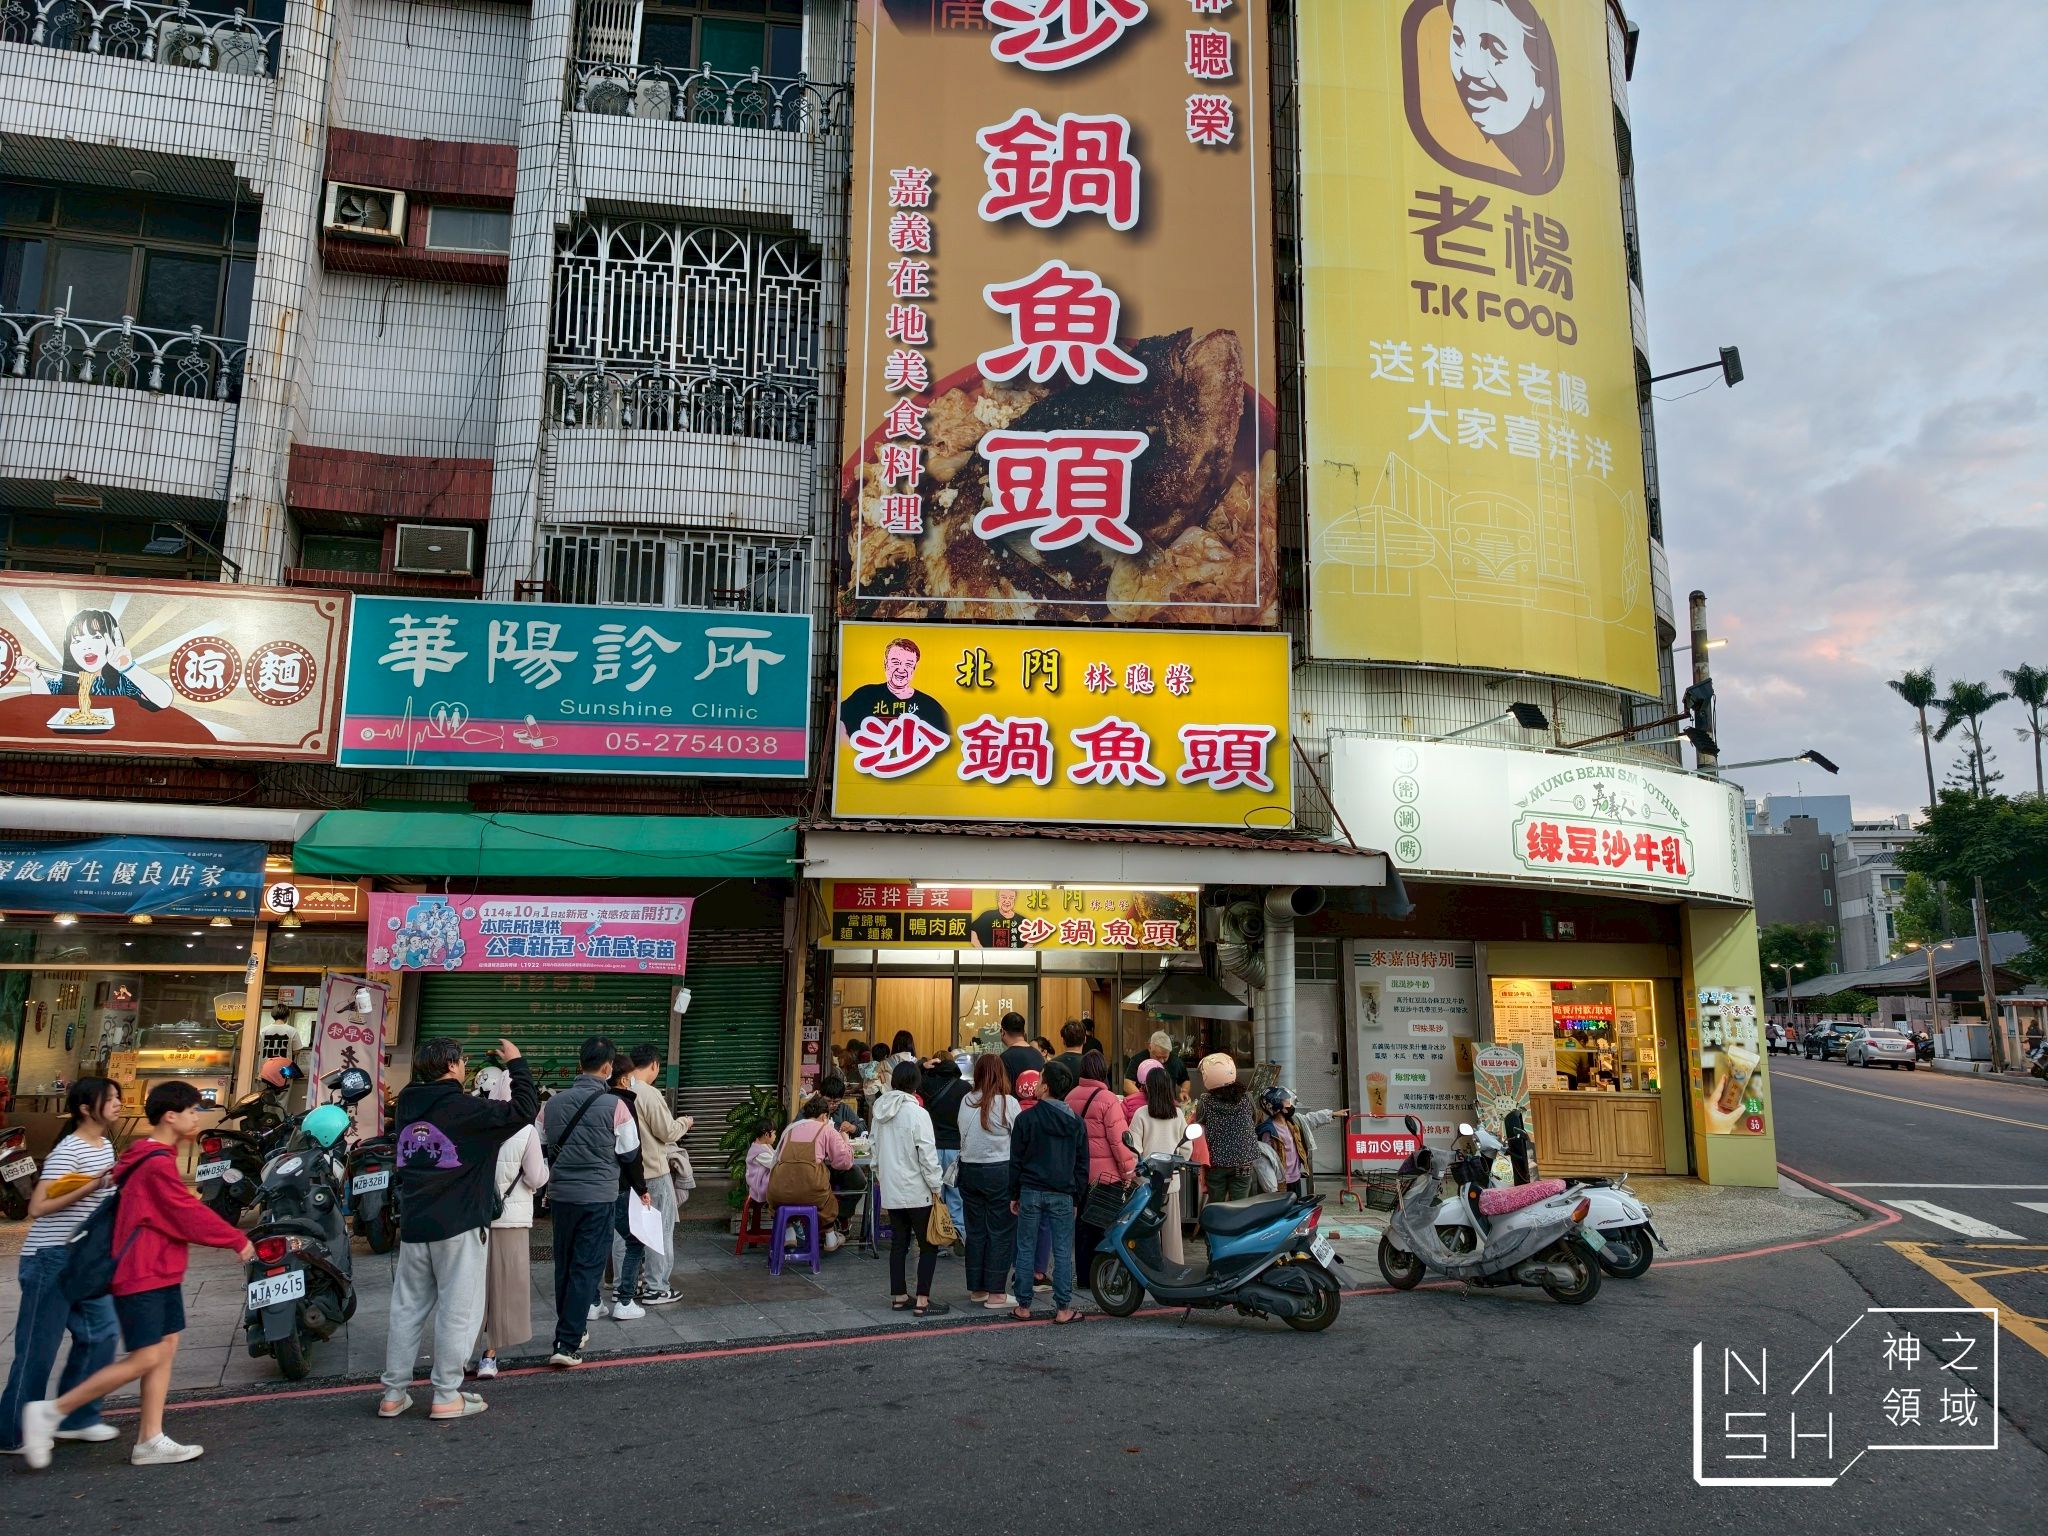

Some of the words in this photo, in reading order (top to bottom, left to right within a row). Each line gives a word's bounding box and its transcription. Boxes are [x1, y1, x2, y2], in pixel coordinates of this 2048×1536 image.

[1186, 0, 1234, 145] 聰榮
[1408, 185, 1573, 300] 老楊
[1411, 280, 1469, 319] T.K
[1477, 290, 1577, 345] FOOD
[882, 166, 931, 534] 嘉義在地美食料理
[1369, 340, 1589, 417] 送禮送老楊
[1408, 400, 1614, 479] 大家喜洋洋
[378, 613, 786, 695] 華陽診所
[956, 646, 1061, 692] 北門
[1085, 663, 1194, 695] 林聰榮
[560, 699, 673, 718] Sunshine
[692, 702, 759, 721] Clinic
[872, 700, 906, 715] 北門
[605, 732, 778, 755] 05-2754038
[850, 713, 1276, 792] 沙鍋魚頭
[1529, 770, 1573, 803] MUNG
[1576, 766, 1615, 780] BEAN
[1396, 748, 1418, 860] 密涮嘴
[272, 887, 295, 908] 麵
[857, 887, 949, 906] 涼拌青菜
[1027, 888, 1084, 911] 北門
[479, 919, 562, 934] 本院所提供
[848, 914, 887, 927] 當歸鴨
[909, 918, 967, 936] 鴨肉飯
[1019, 917, 1180, 947] 沙鍋魚頭
[486, 936, 675, 959] 公費新冠、流感疫苗
[974, 999, 1013, 1016] 北門
[1698, 991, 1734, 1004] 古早味
[250, 1276, 303, 1304] MJA-9615
